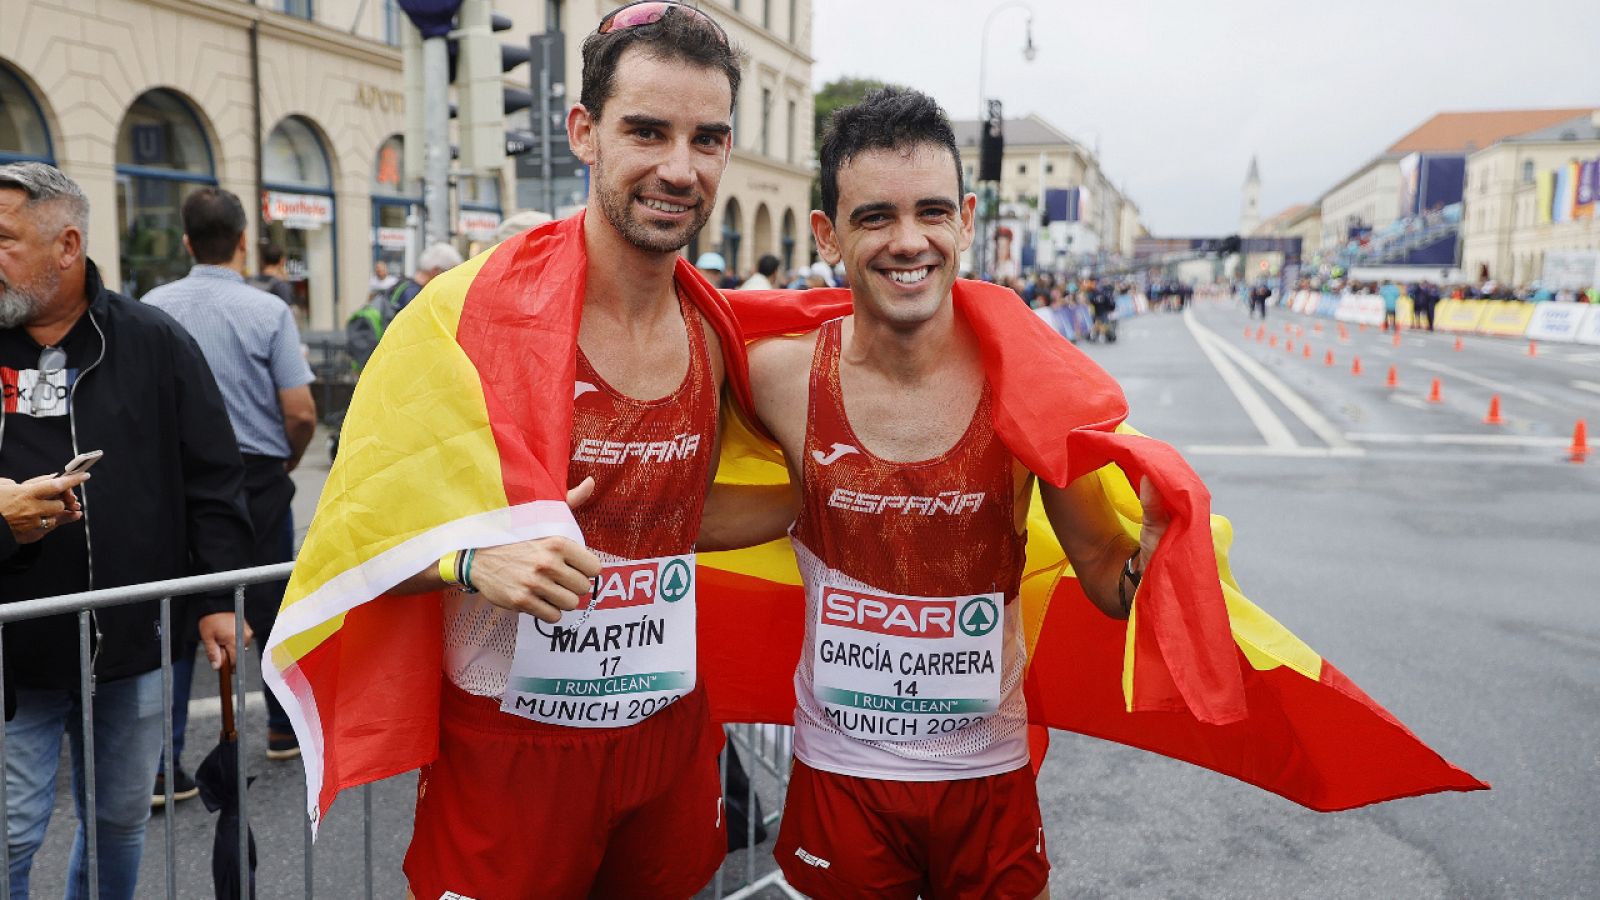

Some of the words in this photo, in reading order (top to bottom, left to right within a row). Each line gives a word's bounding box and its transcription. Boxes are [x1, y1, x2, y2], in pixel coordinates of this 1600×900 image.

[356, 81, 405, 112] APOT
[3, 384, 27, 401] CK
[571, 432, 700, 465] ESPAÑA
[827, 486, 986, 516] ESPAÑA
[588, 569, 656, 603] PAR
[825, 593, 952, 633] SPAR
[549, 615, 665, 653] MARTÍN
[599, 656, 622, 677] 17
[820, 639, 893, 674] GARCÍA
[899, 650, 995, 676] CARRERA
[556, 683, 560, 693] I
[565, 682, 601, 694] RUN
[854, 694, 858, 705] I
[863, 695, 896, 710] RUN
[893, 680, 918, 697] 14
[515, 696, 619, 721] MUNICH
[824, 706, 918, 736] MUNICH
[795, 847, 831, 869] ESP
